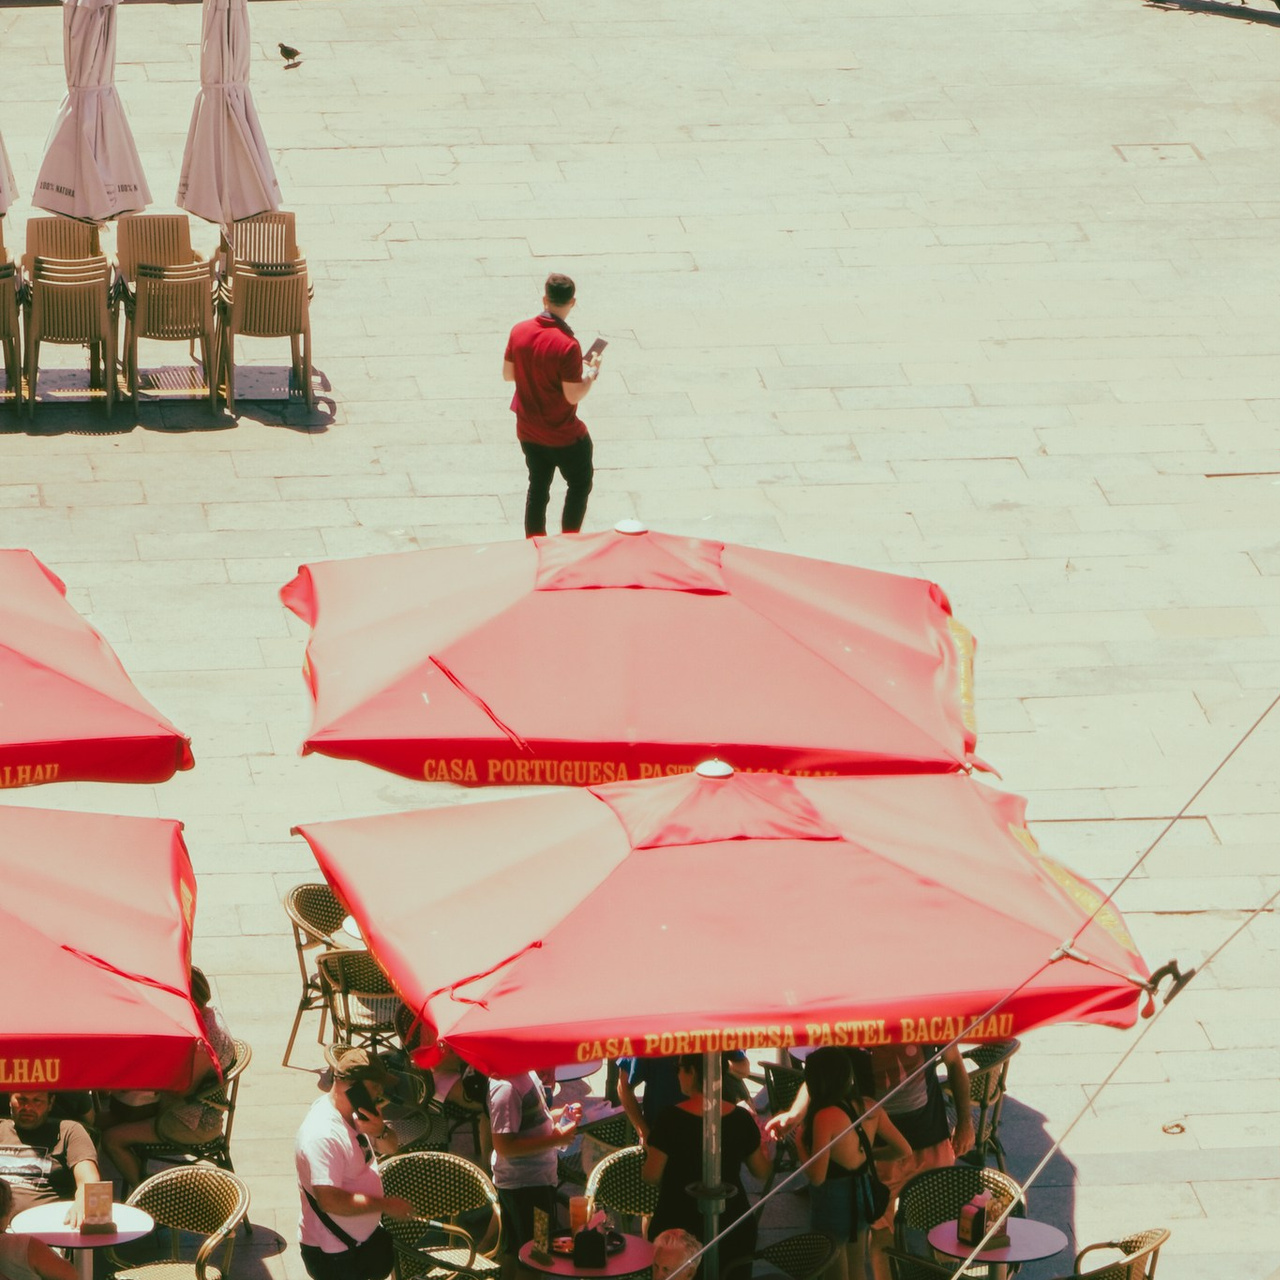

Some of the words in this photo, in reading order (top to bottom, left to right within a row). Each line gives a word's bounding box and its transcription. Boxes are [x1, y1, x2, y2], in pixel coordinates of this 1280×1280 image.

[423, 758, 478, 783] CASA
[487, 759, 629, 785] PORTUGUESA
[576, 1036, 633, 1063] CASA
[644, 1024, 796, 1055] PORTUGUESA
[805, 1019, 892, 1047] PASTEL
[900, 1013, 1015, 1043] BACALHAU
